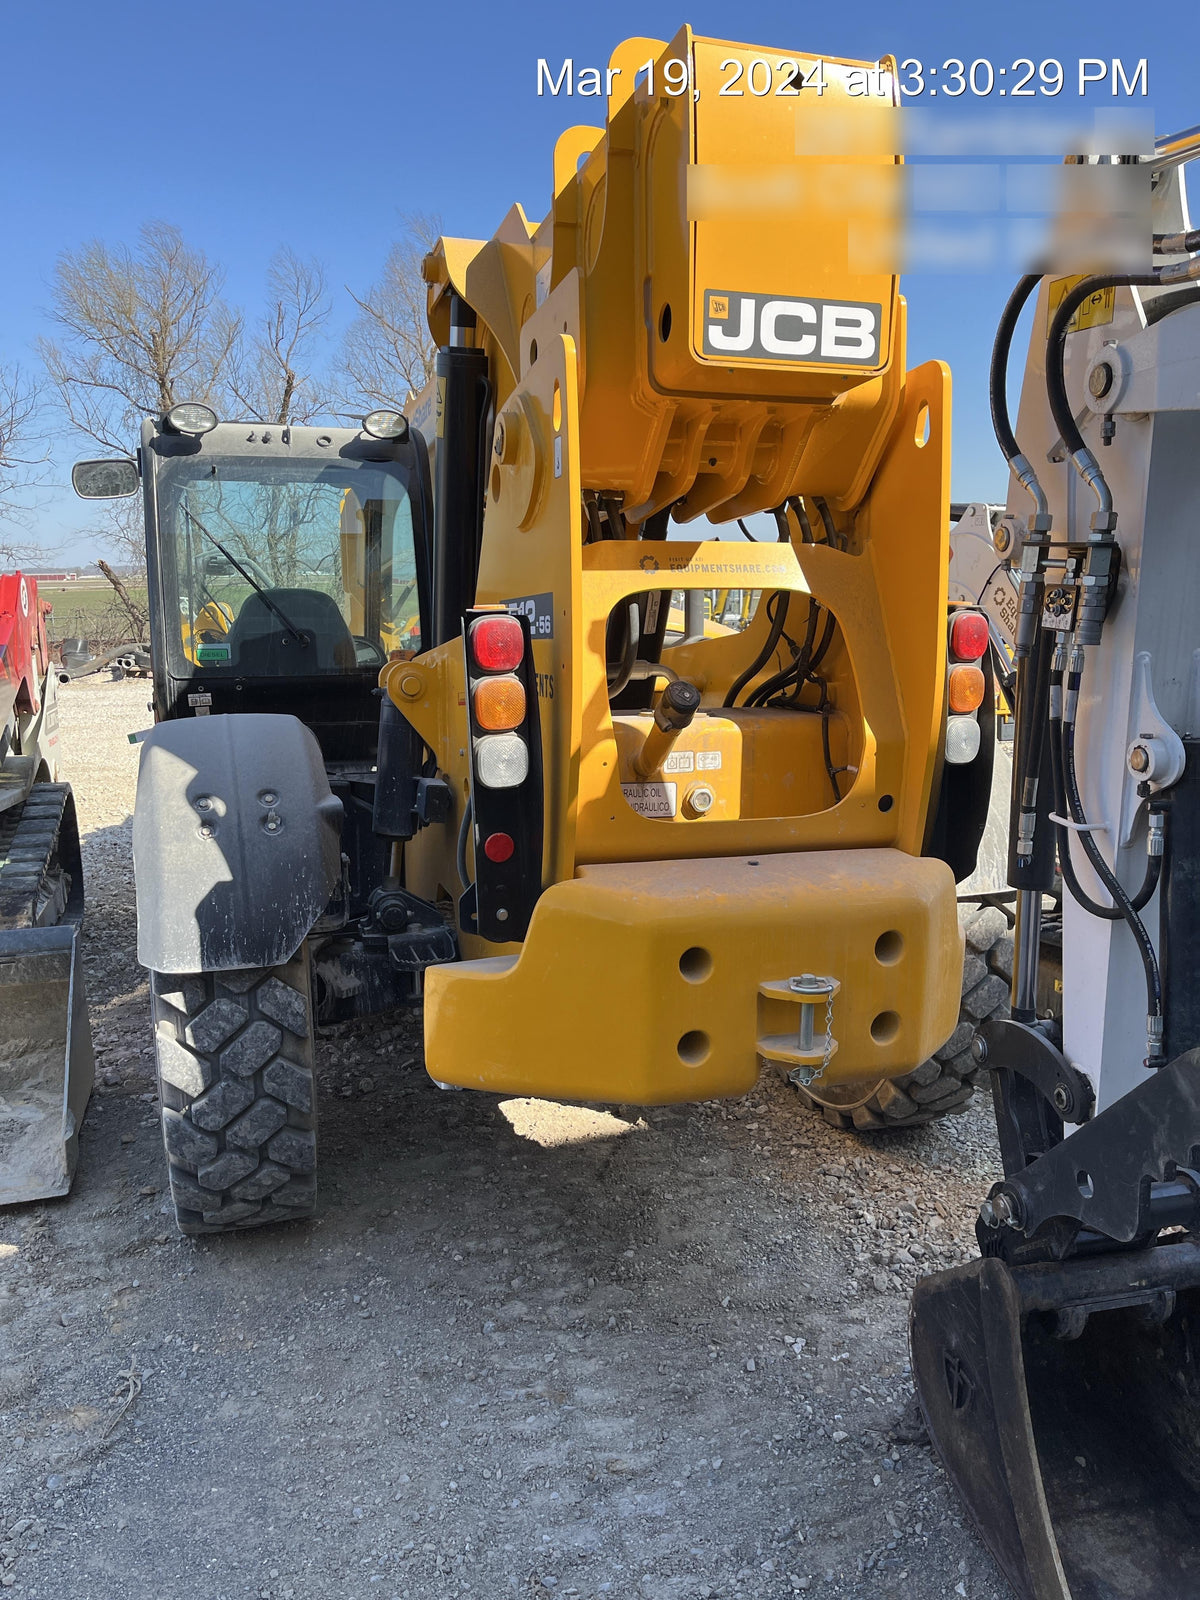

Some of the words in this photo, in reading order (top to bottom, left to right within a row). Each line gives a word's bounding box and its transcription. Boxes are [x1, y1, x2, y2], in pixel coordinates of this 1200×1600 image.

[708, 298, 876, 359] JCB
[669, 563, 787, 574] EQUIPMENTSHARE.COM
[650, 788, 662, 798] OIL
